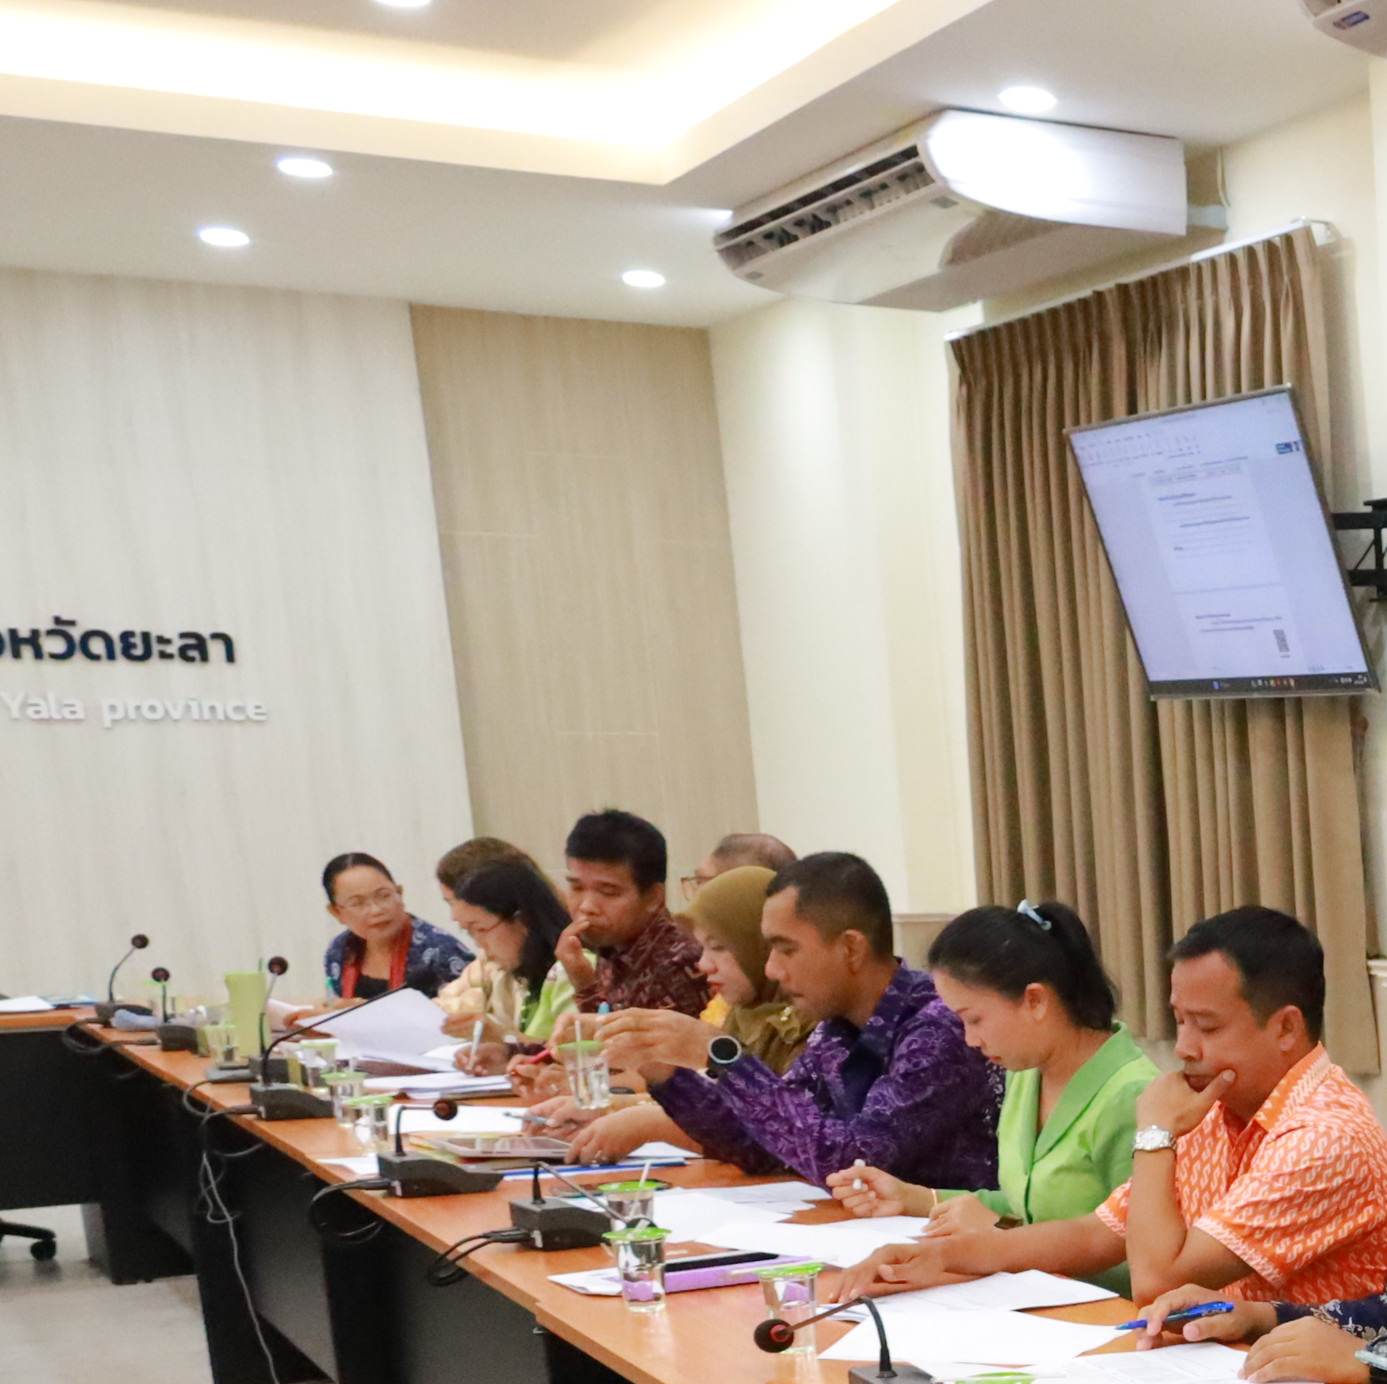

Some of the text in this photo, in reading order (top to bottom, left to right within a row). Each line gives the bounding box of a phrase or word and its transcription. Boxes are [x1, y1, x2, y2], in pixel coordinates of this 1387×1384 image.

[0, 616, 236, 663] หวัดยะลา
[0, 692, 268, 730] Yala province
